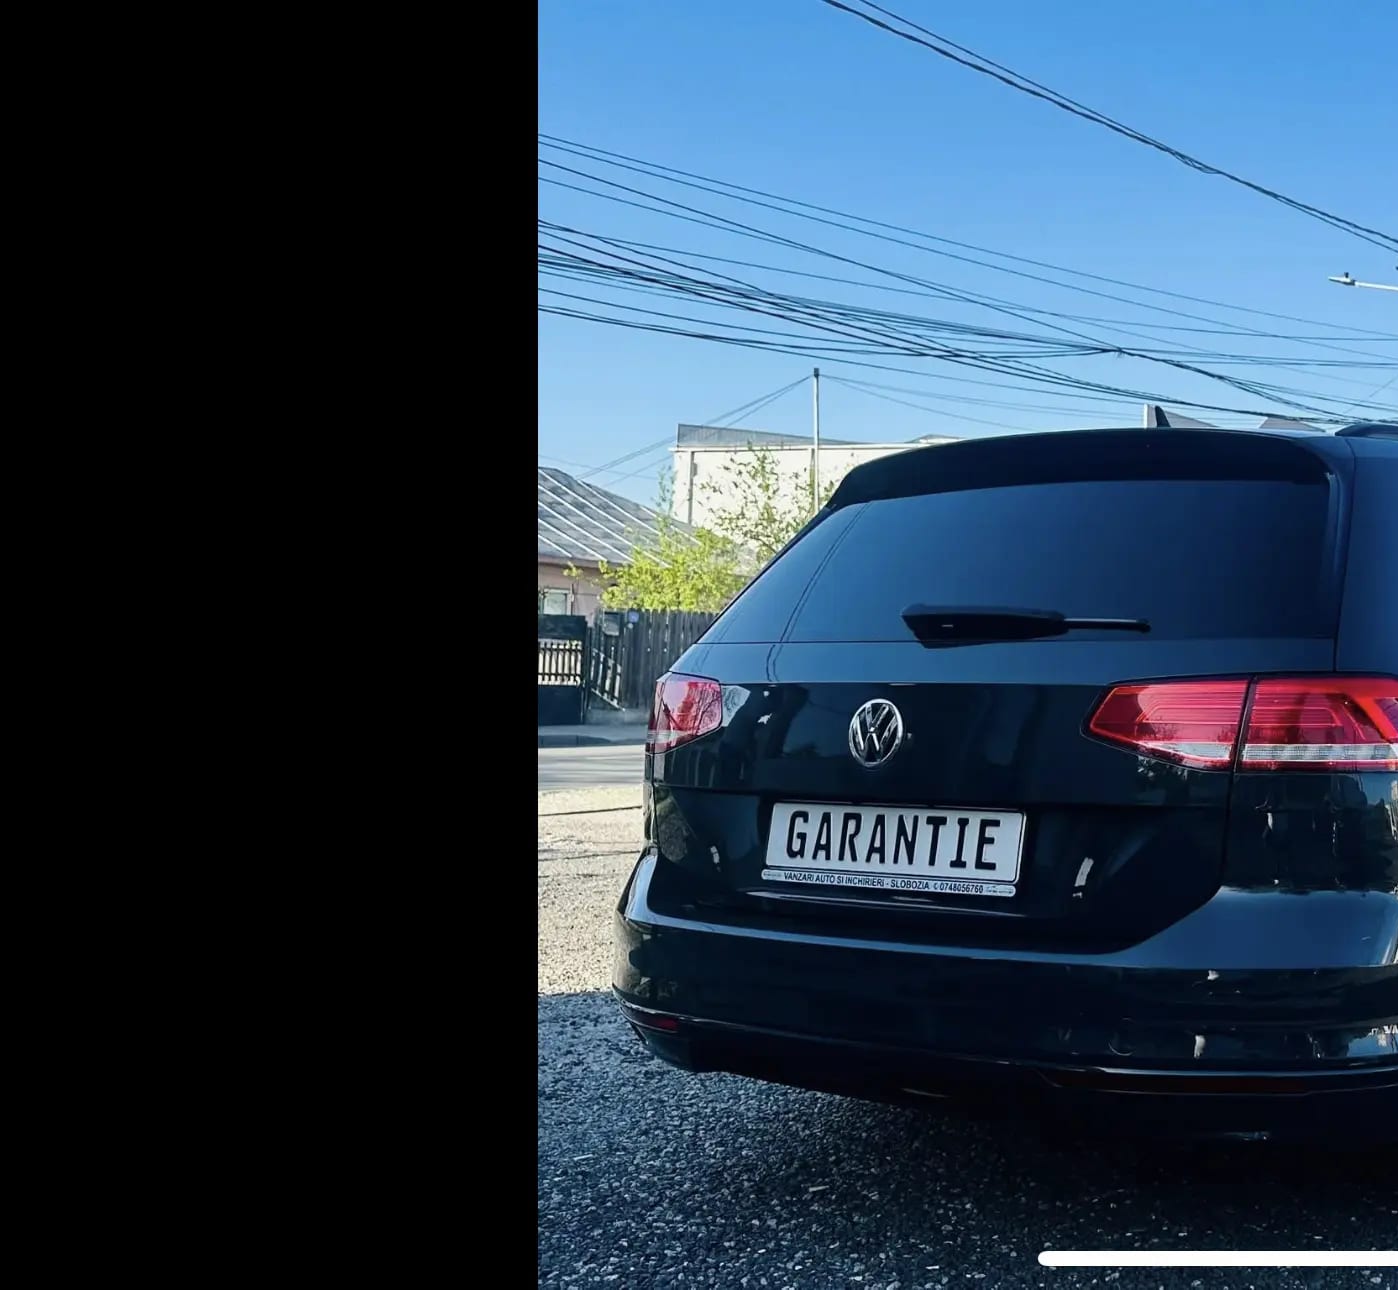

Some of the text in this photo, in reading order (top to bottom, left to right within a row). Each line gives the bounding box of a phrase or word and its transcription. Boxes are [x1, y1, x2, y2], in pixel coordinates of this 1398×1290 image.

[786, 810, 1001, 870] GARANTIE
[784, 871, 814, 882] VANZARI
[815, 874, 835, 884] AUTO
[836, 876, 845, 884] SI
[845, 876, 884, 887] INCHIRIERI
[890, 879, 930, 890] SLOBOZIA
